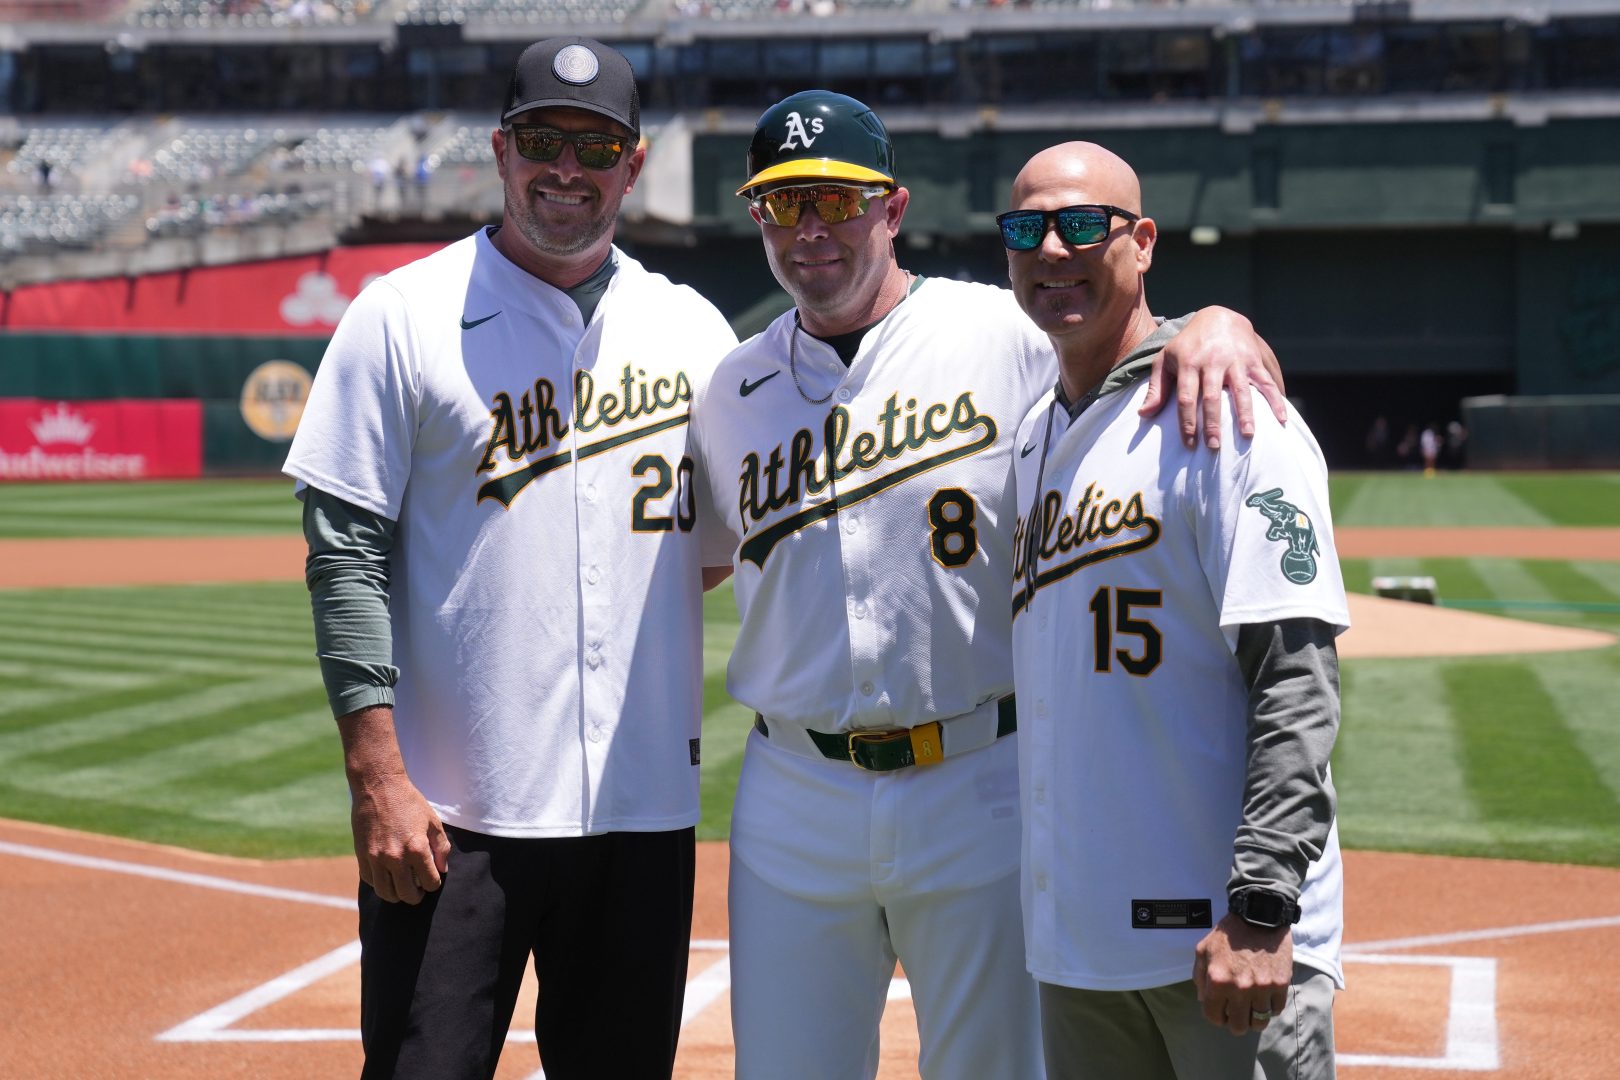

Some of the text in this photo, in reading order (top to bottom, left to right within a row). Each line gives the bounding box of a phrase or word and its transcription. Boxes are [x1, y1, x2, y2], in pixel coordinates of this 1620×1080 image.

[778, 111, 825, 151] A's
[475, 361, 692, 476] Athletics
[0, 445, 145, 478] udweiser
[630, 454, 696, 533] 20
[738, 390, 980, 535] Athletics
[928, 487, 978, 568] 8
[1089, 585, 1163, 677] 15
[922, 740, 932, 757] 8
